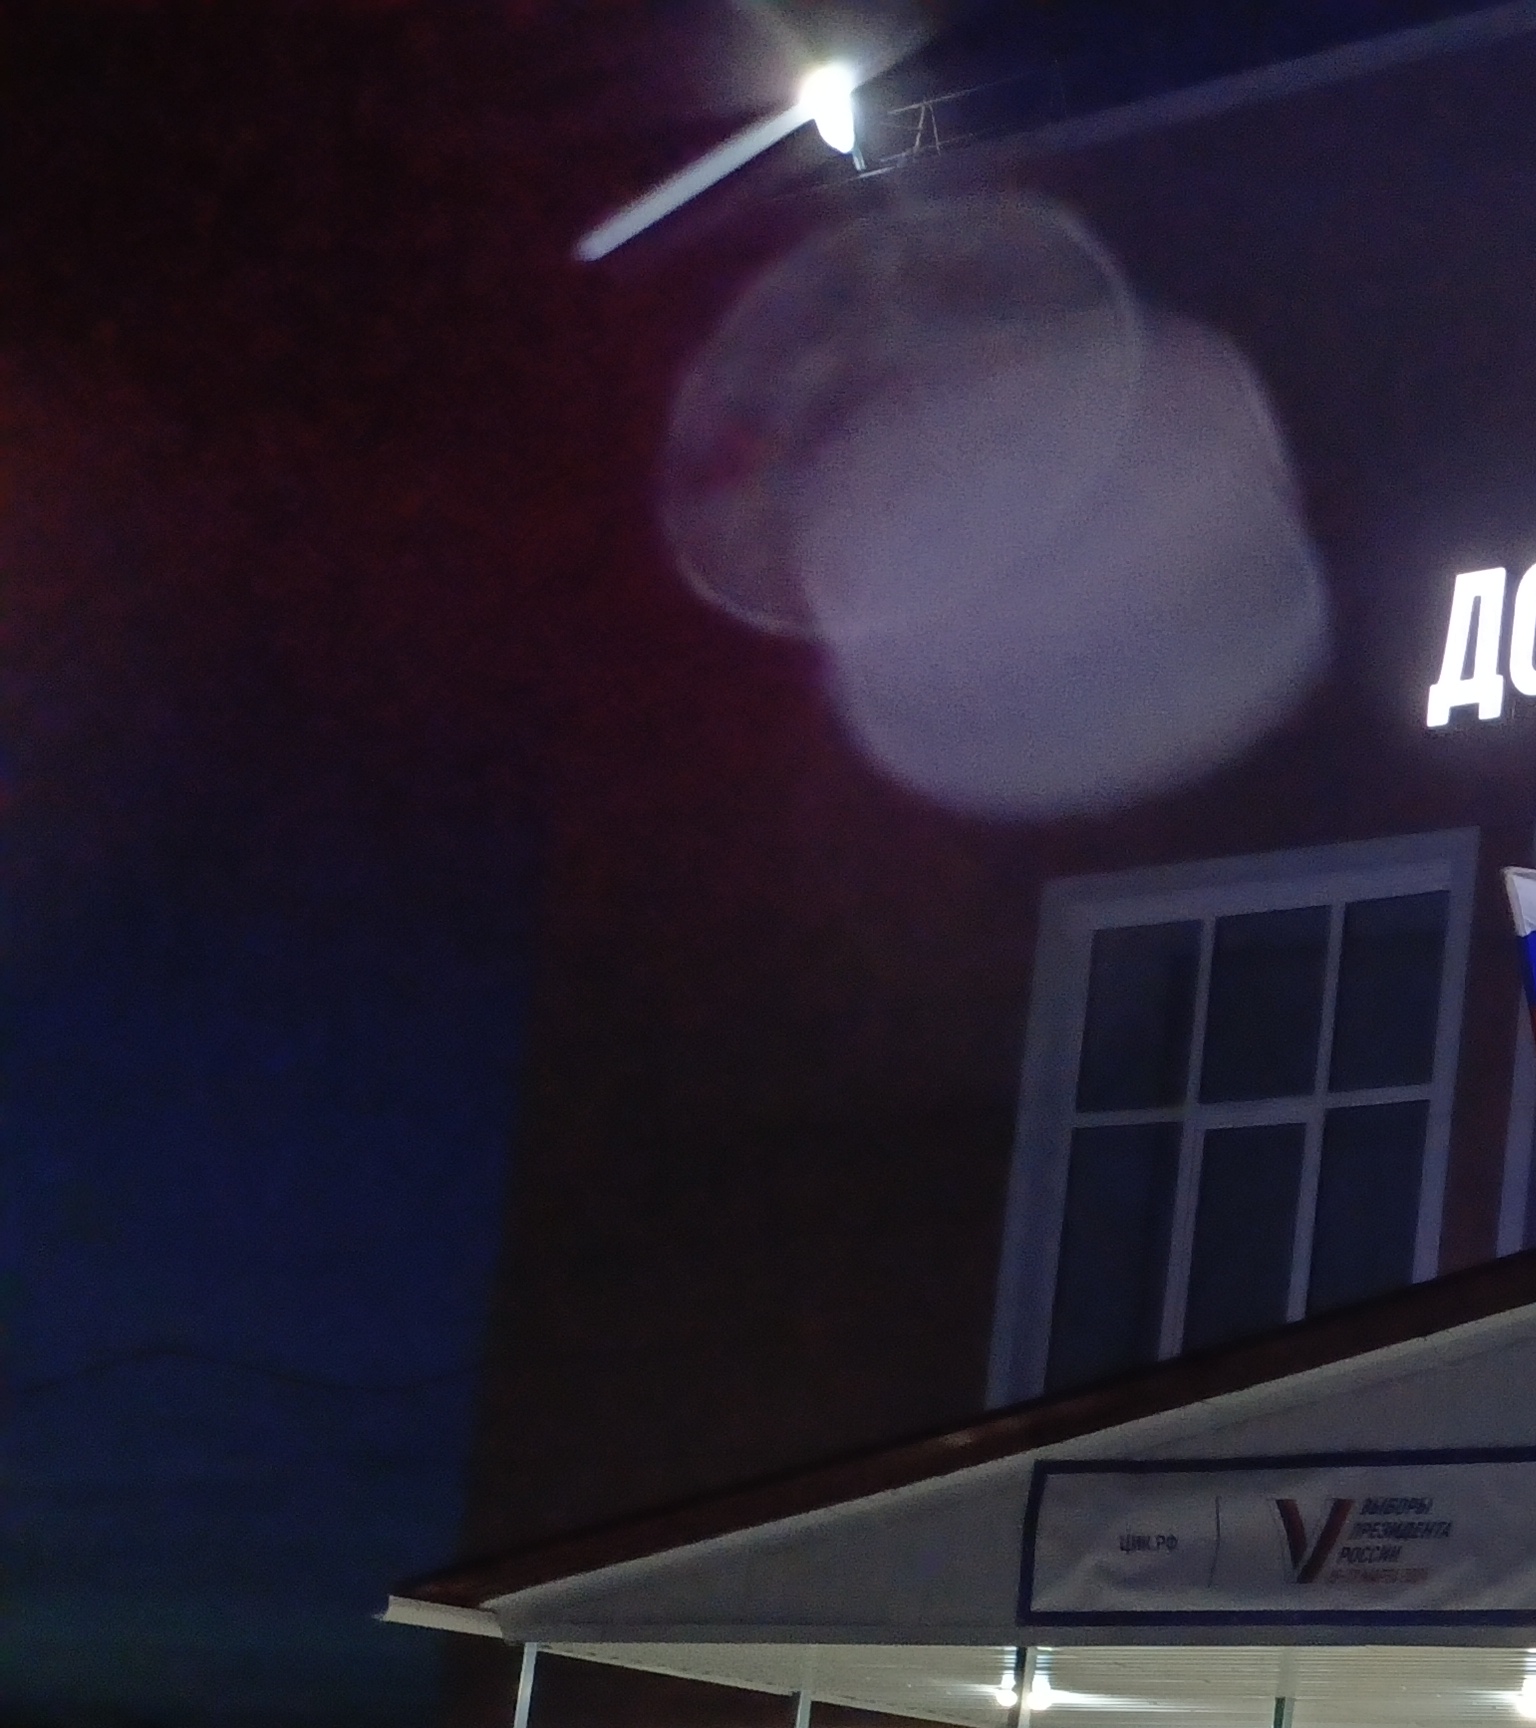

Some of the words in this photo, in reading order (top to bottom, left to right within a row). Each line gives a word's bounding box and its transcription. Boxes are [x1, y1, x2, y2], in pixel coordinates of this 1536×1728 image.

[1360, 1497, 1433, 1515] ВЫБОРЫ
[1348, 1521, 1453, 1541] ПРЕЗИДЕНТА
[1337, 1546, 1402, 1563] РОССИИ
